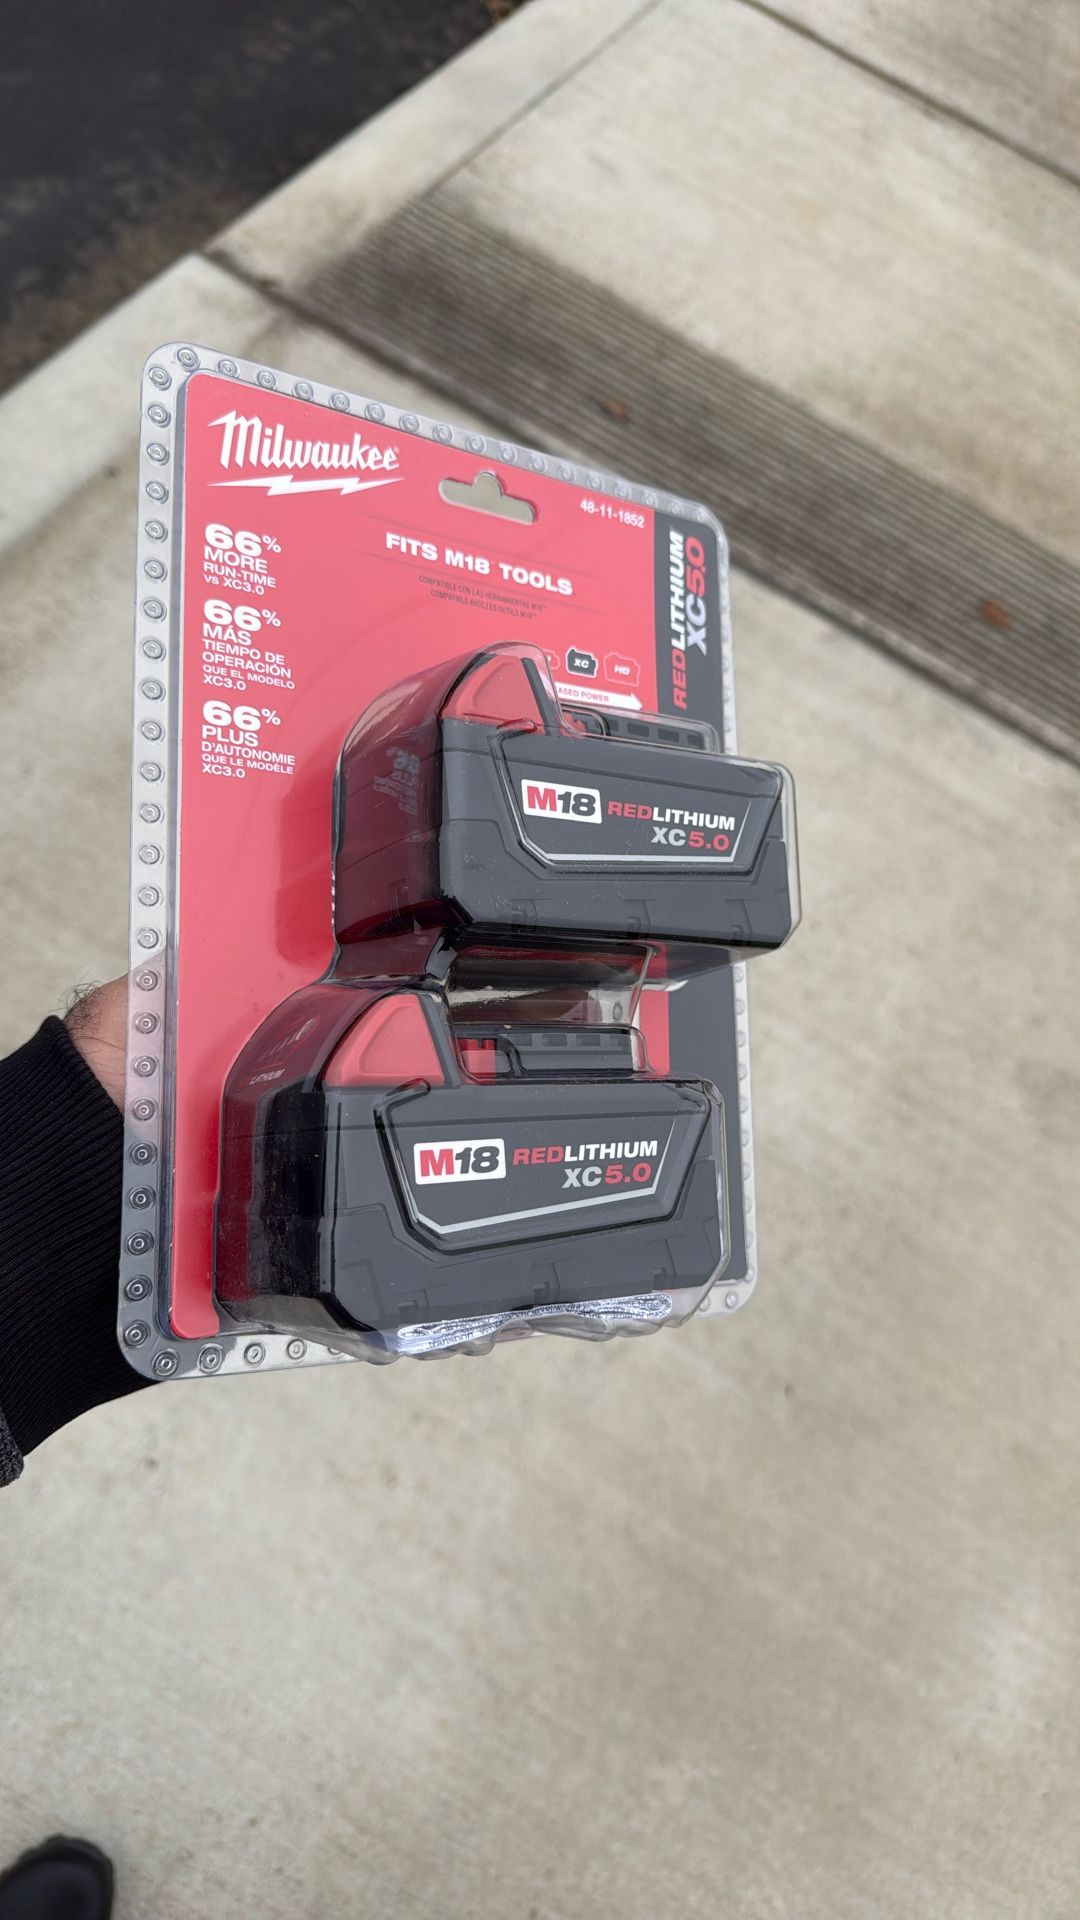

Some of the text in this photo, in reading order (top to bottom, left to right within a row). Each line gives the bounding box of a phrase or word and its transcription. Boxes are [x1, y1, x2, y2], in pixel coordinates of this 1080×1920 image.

[207, 410, 400, 471] Milwaukee
[580, 499, 645, 529] 48-11-1852
[204, 523, 282, 557] 66%
[204, 546, 268, 574] MORE
[385, 532, 438, 561] FITS
[499, 563, 573, 596] TOOLS
[203, 562, 277, 588] RUN-TIME
[223, 577, 265, 595] XC3.0
[685, 536, 707, 656] XC5.0
[203, 599, 281, 632] 66%
[669, 528, 688, 710] REDLITHIUM
[202, 623, 252, 646] MÁS
[202, 639, 285, 665] TIEMPO DE
[574, 658, 590, 669] XC
[202, 652, 292, 679] OPERACIÓN
[202, 664, 295, 690] QUE EL MODELO
[614, 665, 631, 676] HD
[203, 674, 247, 691] XC3.0
[581, 691, 609, 703] POWER
[202, 700, 281, 732] 66%
[202, 725, 259, 748] PLUS
[201, 753, 294, 775] QUE LE MODÈLE
[201, 763, 246, 779] XC3.0
[526, 785, 735, 831] M18 REDLITHIUM
[419, 1140, 658, 1177] M18 REDLITHIUM
